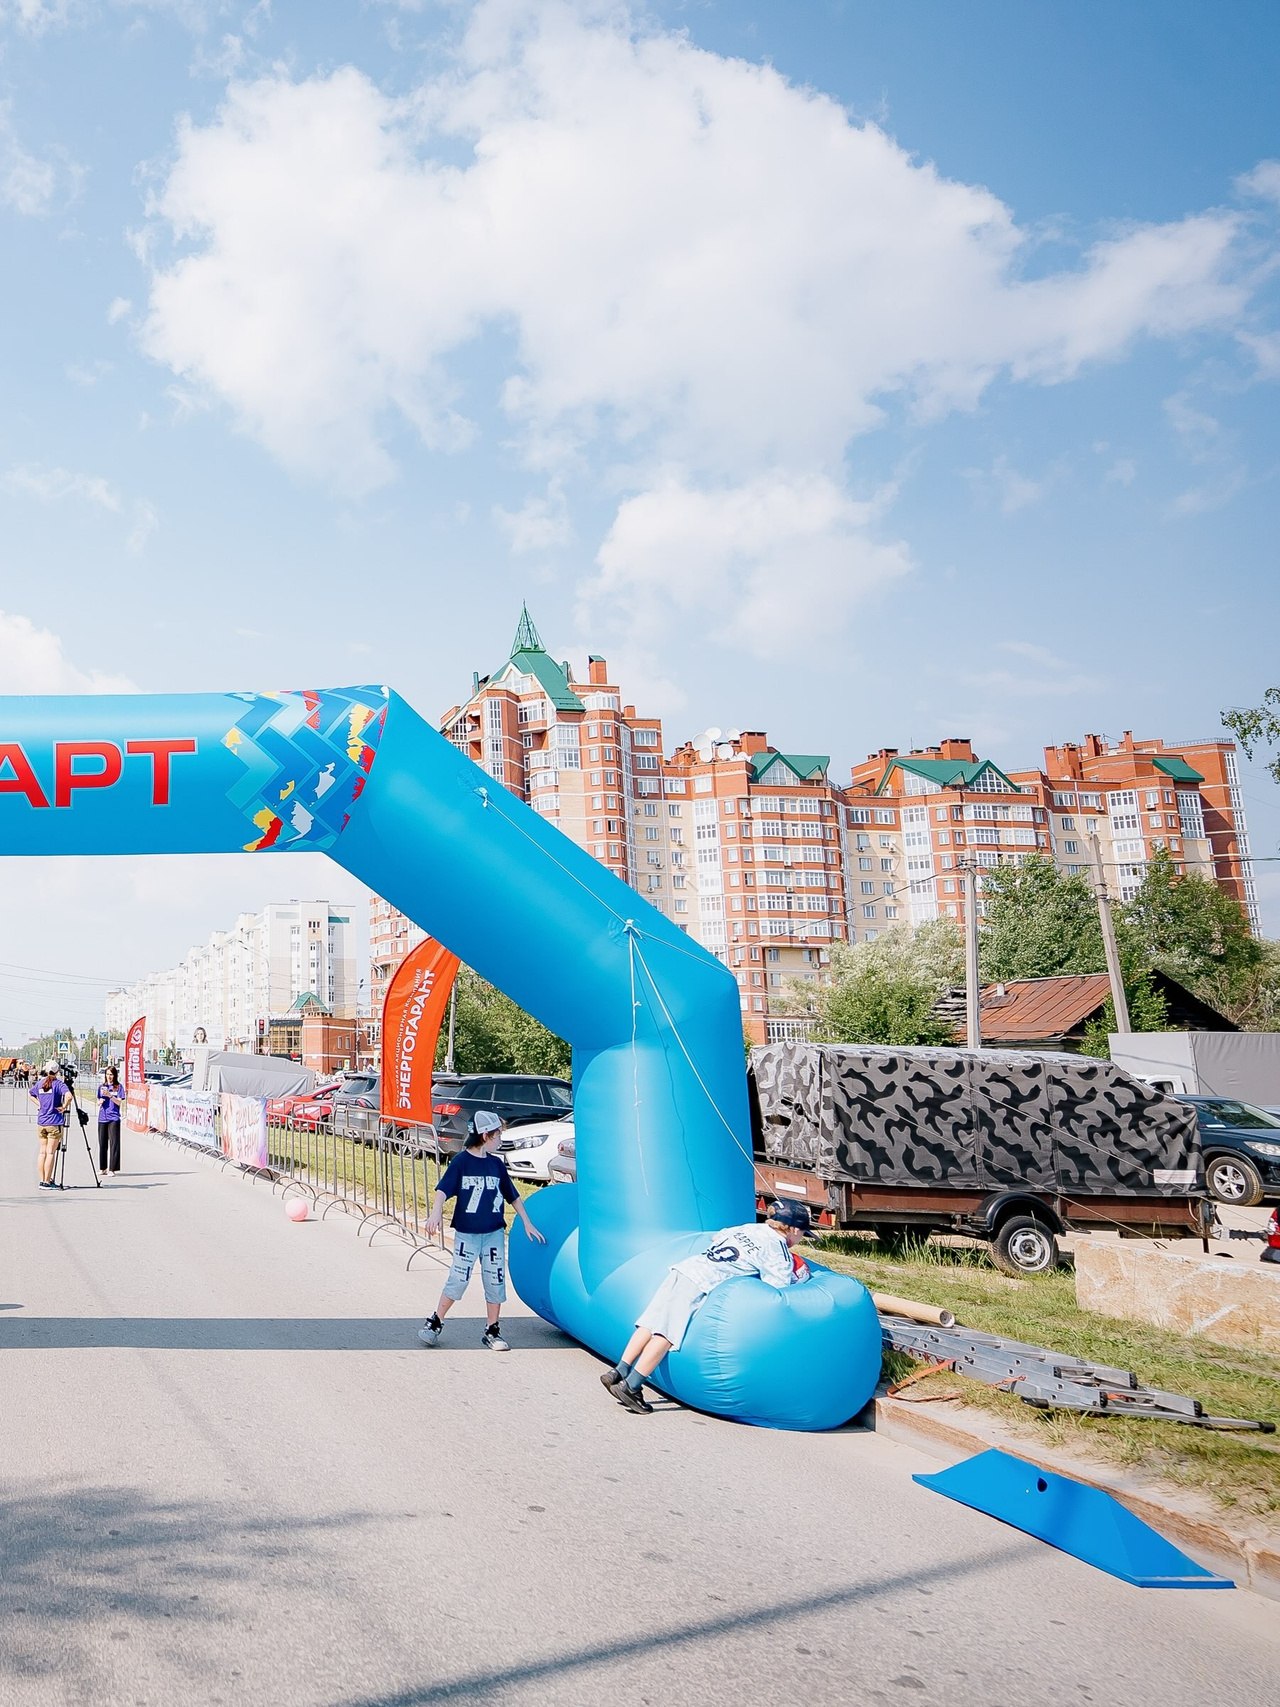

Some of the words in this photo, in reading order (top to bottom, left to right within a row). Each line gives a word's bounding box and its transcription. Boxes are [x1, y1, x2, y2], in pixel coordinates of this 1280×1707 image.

[395, 1009, 408, 1063] АКЦИОНЕРНАЯ
[399, 969, 436, 1110] ЭНЕРГОГАРАНТ
[132, 1047, 141, 1083] ЕГИОН
[461, 1175, 504, 1214] 77
